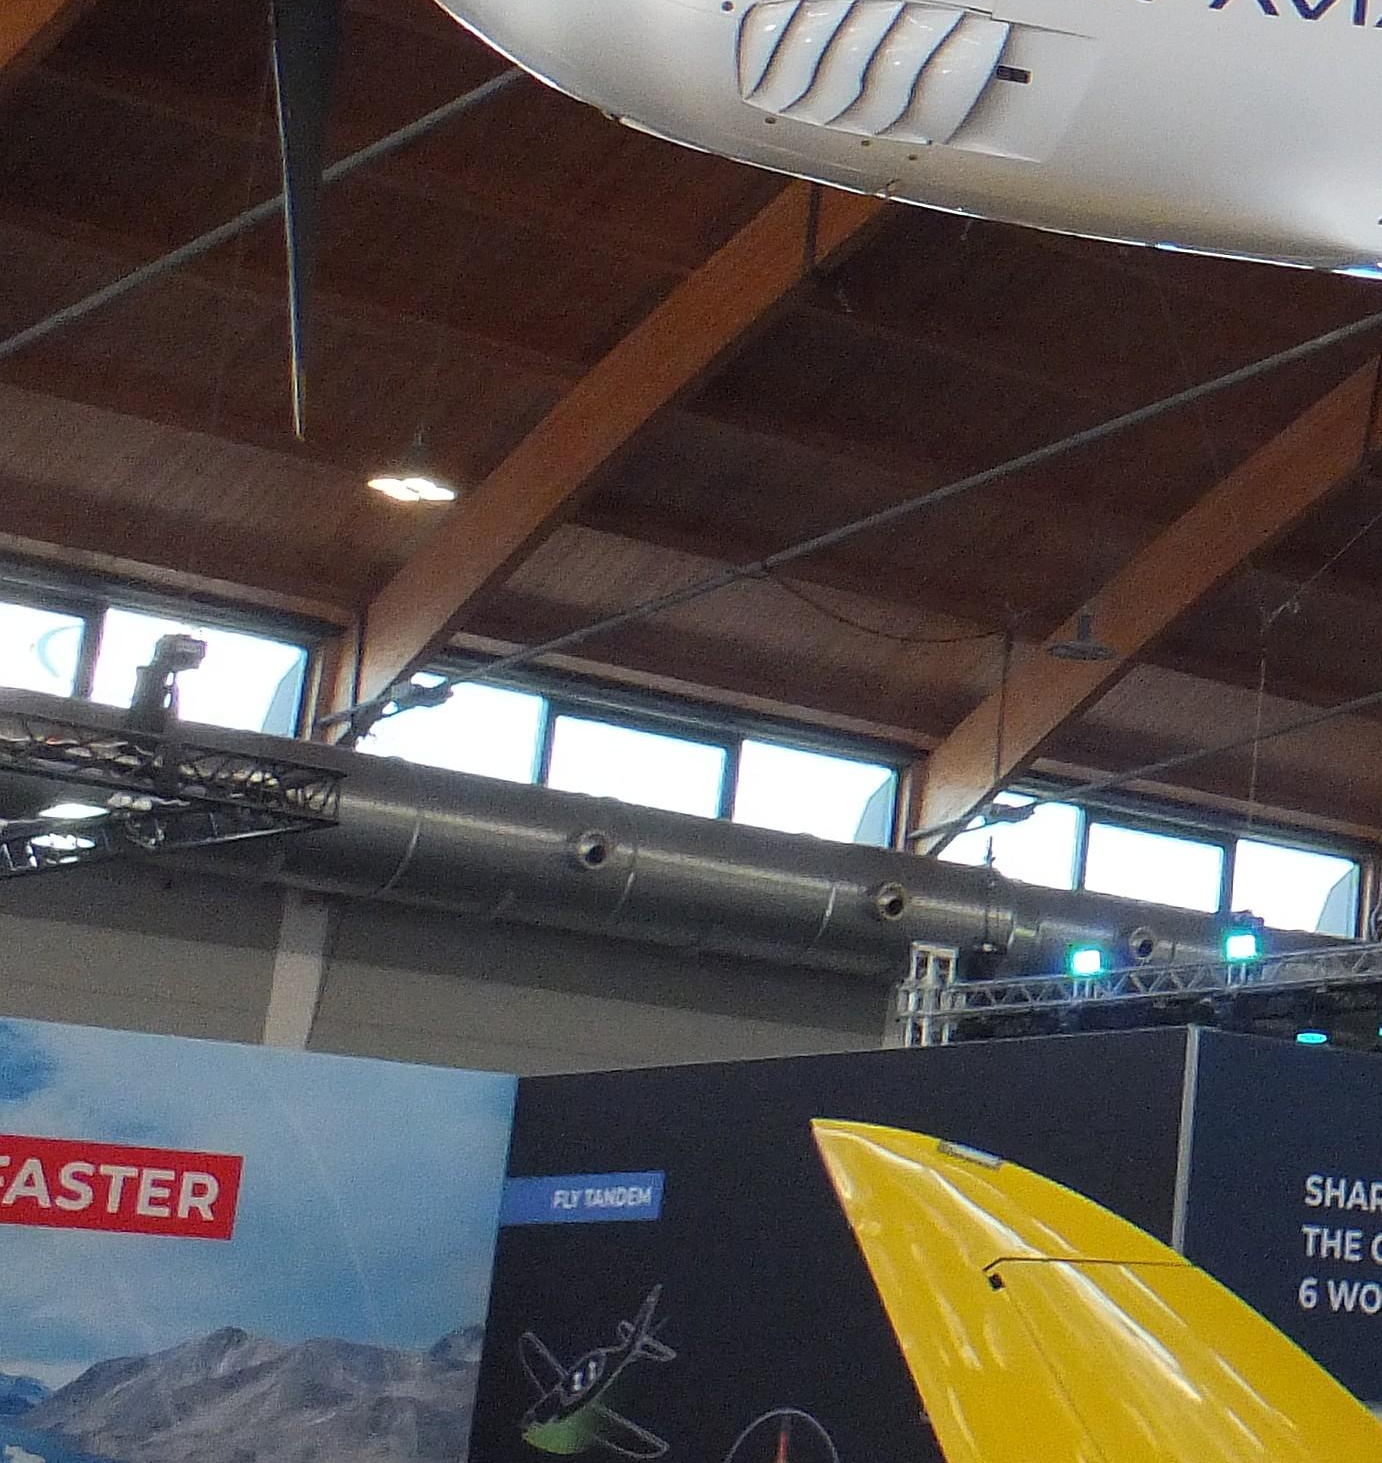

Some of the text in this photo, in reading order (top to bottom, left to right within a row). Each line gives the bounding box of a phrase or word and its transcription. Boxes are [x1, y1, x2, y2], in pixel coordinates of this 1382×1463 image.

[553, 1186, 652, 1210] FLY TANDEM
[1302, 1224, 1363, 1263] THE
[1298, 1276, 1318, 1310] 6
